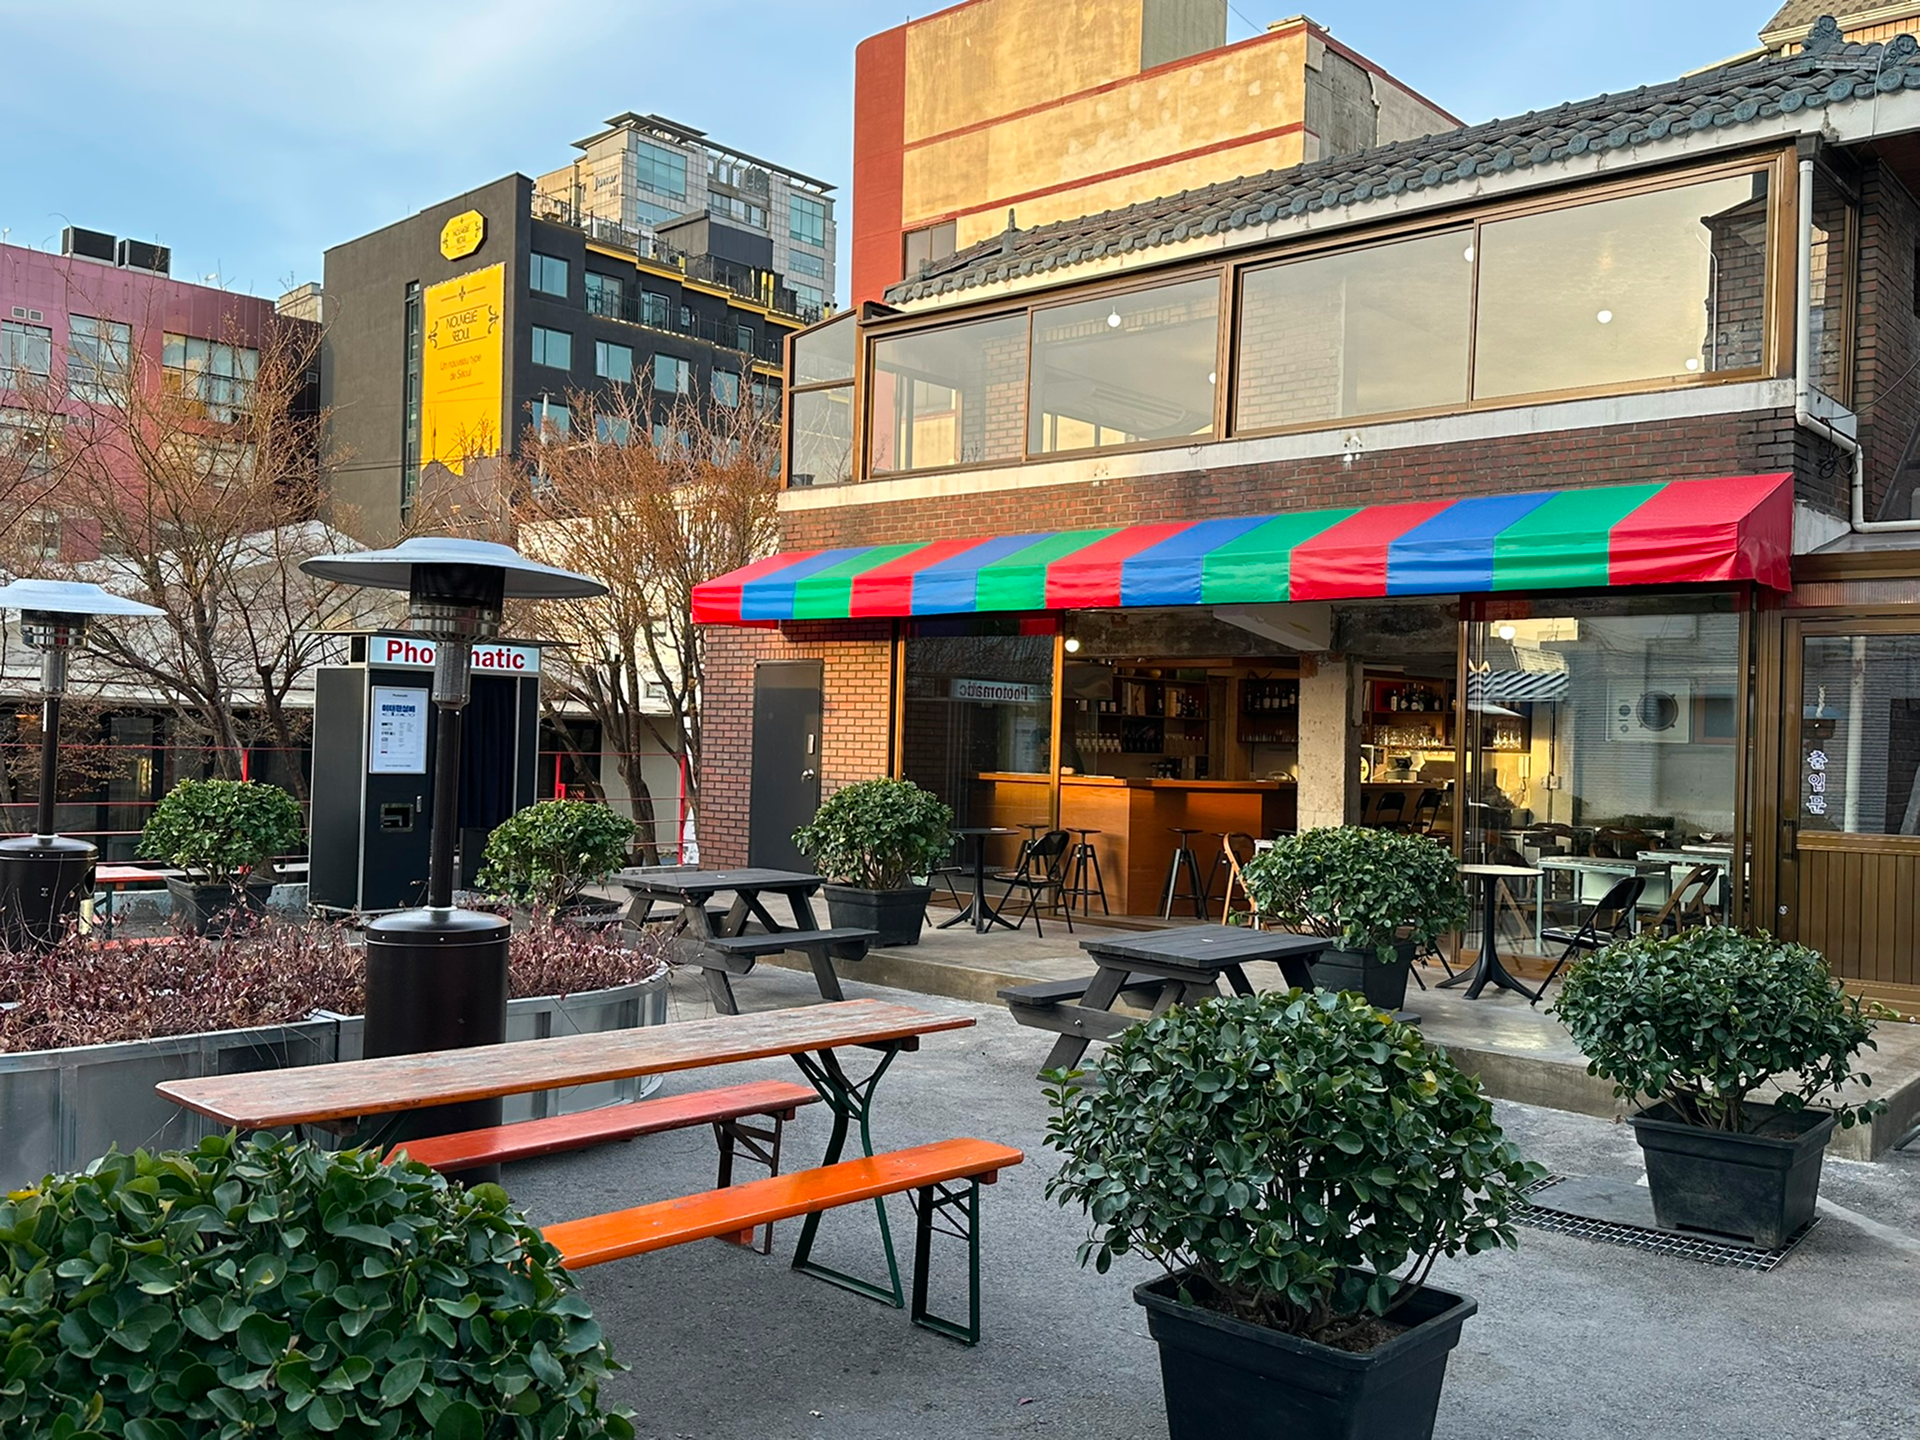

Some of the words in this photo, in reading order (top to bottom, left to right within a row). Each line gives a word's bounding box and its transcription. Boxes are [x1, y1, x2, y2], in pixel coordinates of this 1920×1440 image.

[445, 310, 478, 329] NOUVELLE
[452, 327, 470, 342] SEOUL
[448, 357, 469, 368] nouveau
[457, 367, 472, 379] Seoul
[1805, 749, 1829, 815] 출입문
